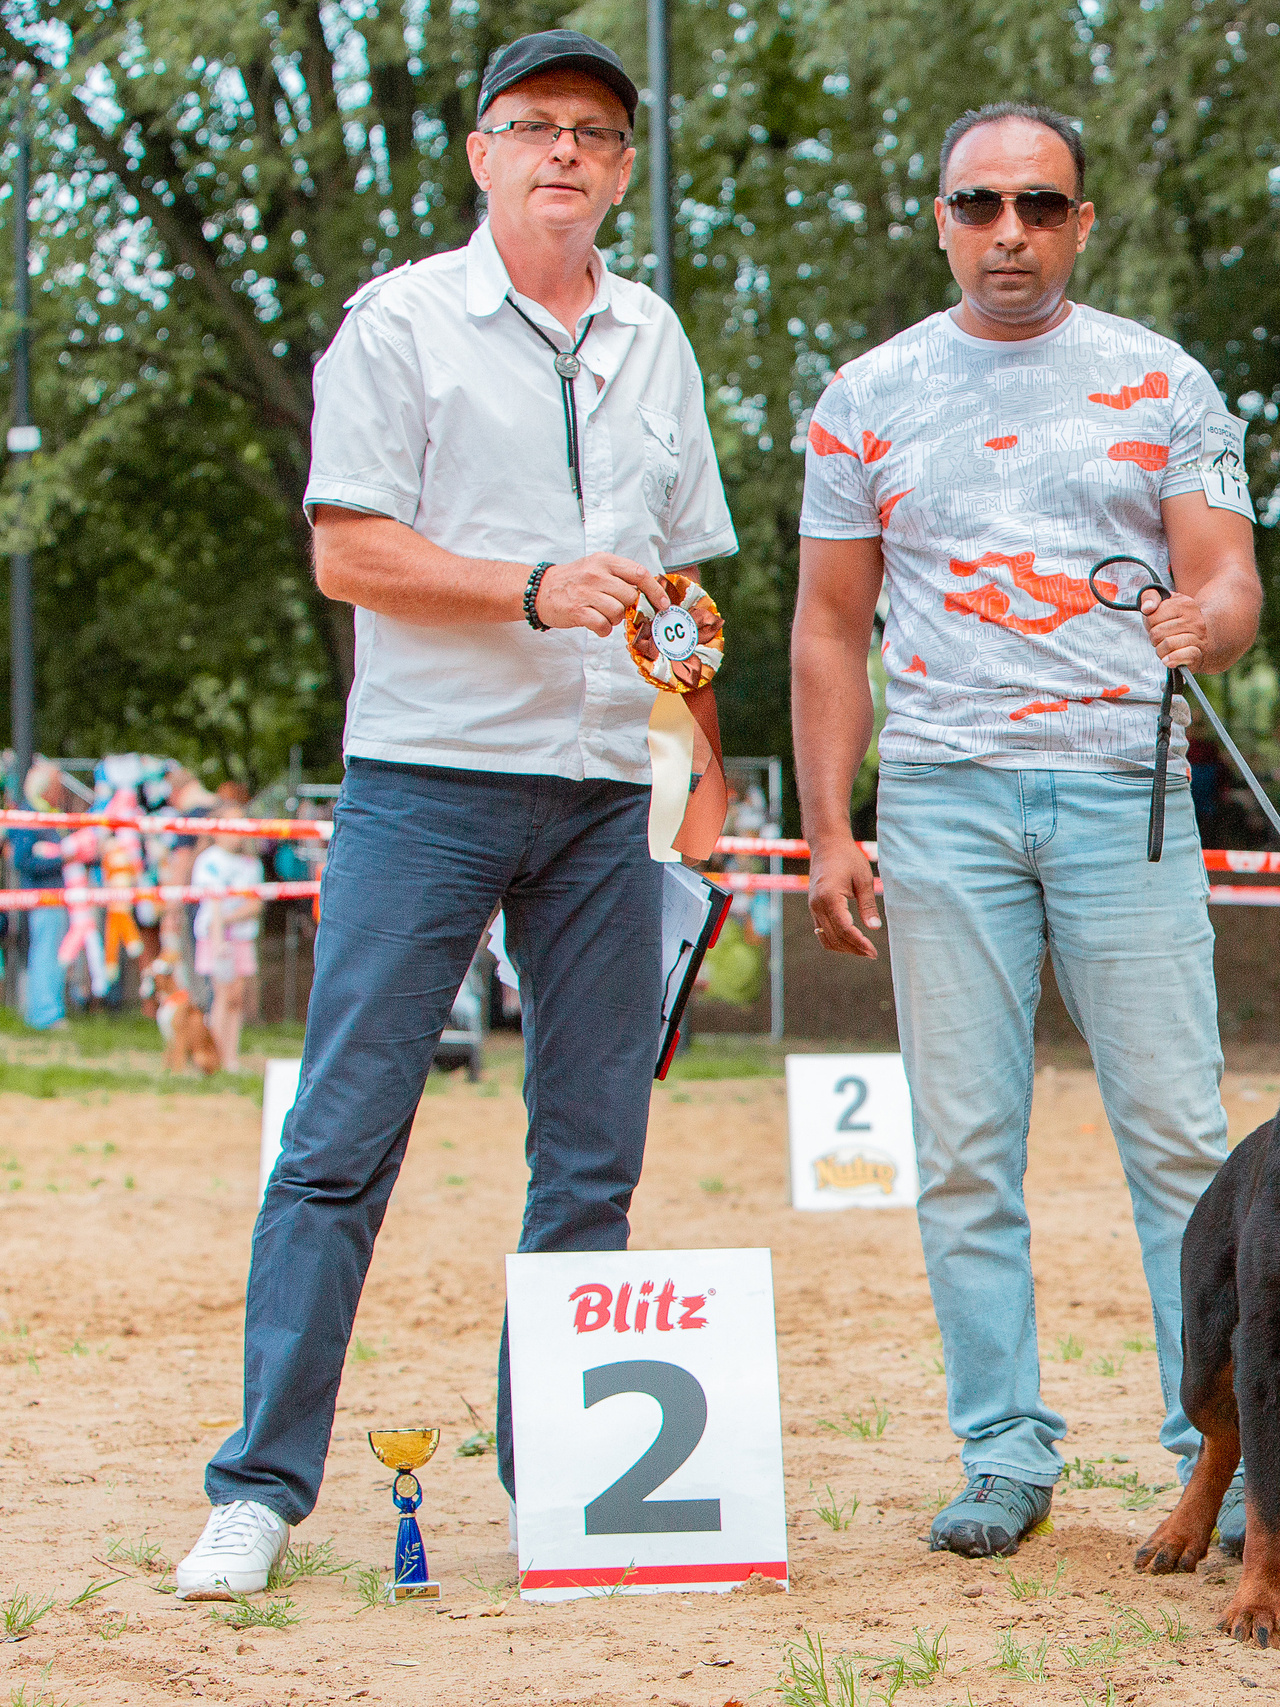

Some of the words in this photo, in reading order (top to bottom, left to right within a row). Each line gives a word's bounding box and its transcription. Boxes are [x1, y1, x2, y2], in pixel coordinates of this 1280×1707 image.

[834, 1075, 871, 1131] 2
[568, 1278, 710, 1334] Blitz
[583, 1359, 722, 1536] 2
